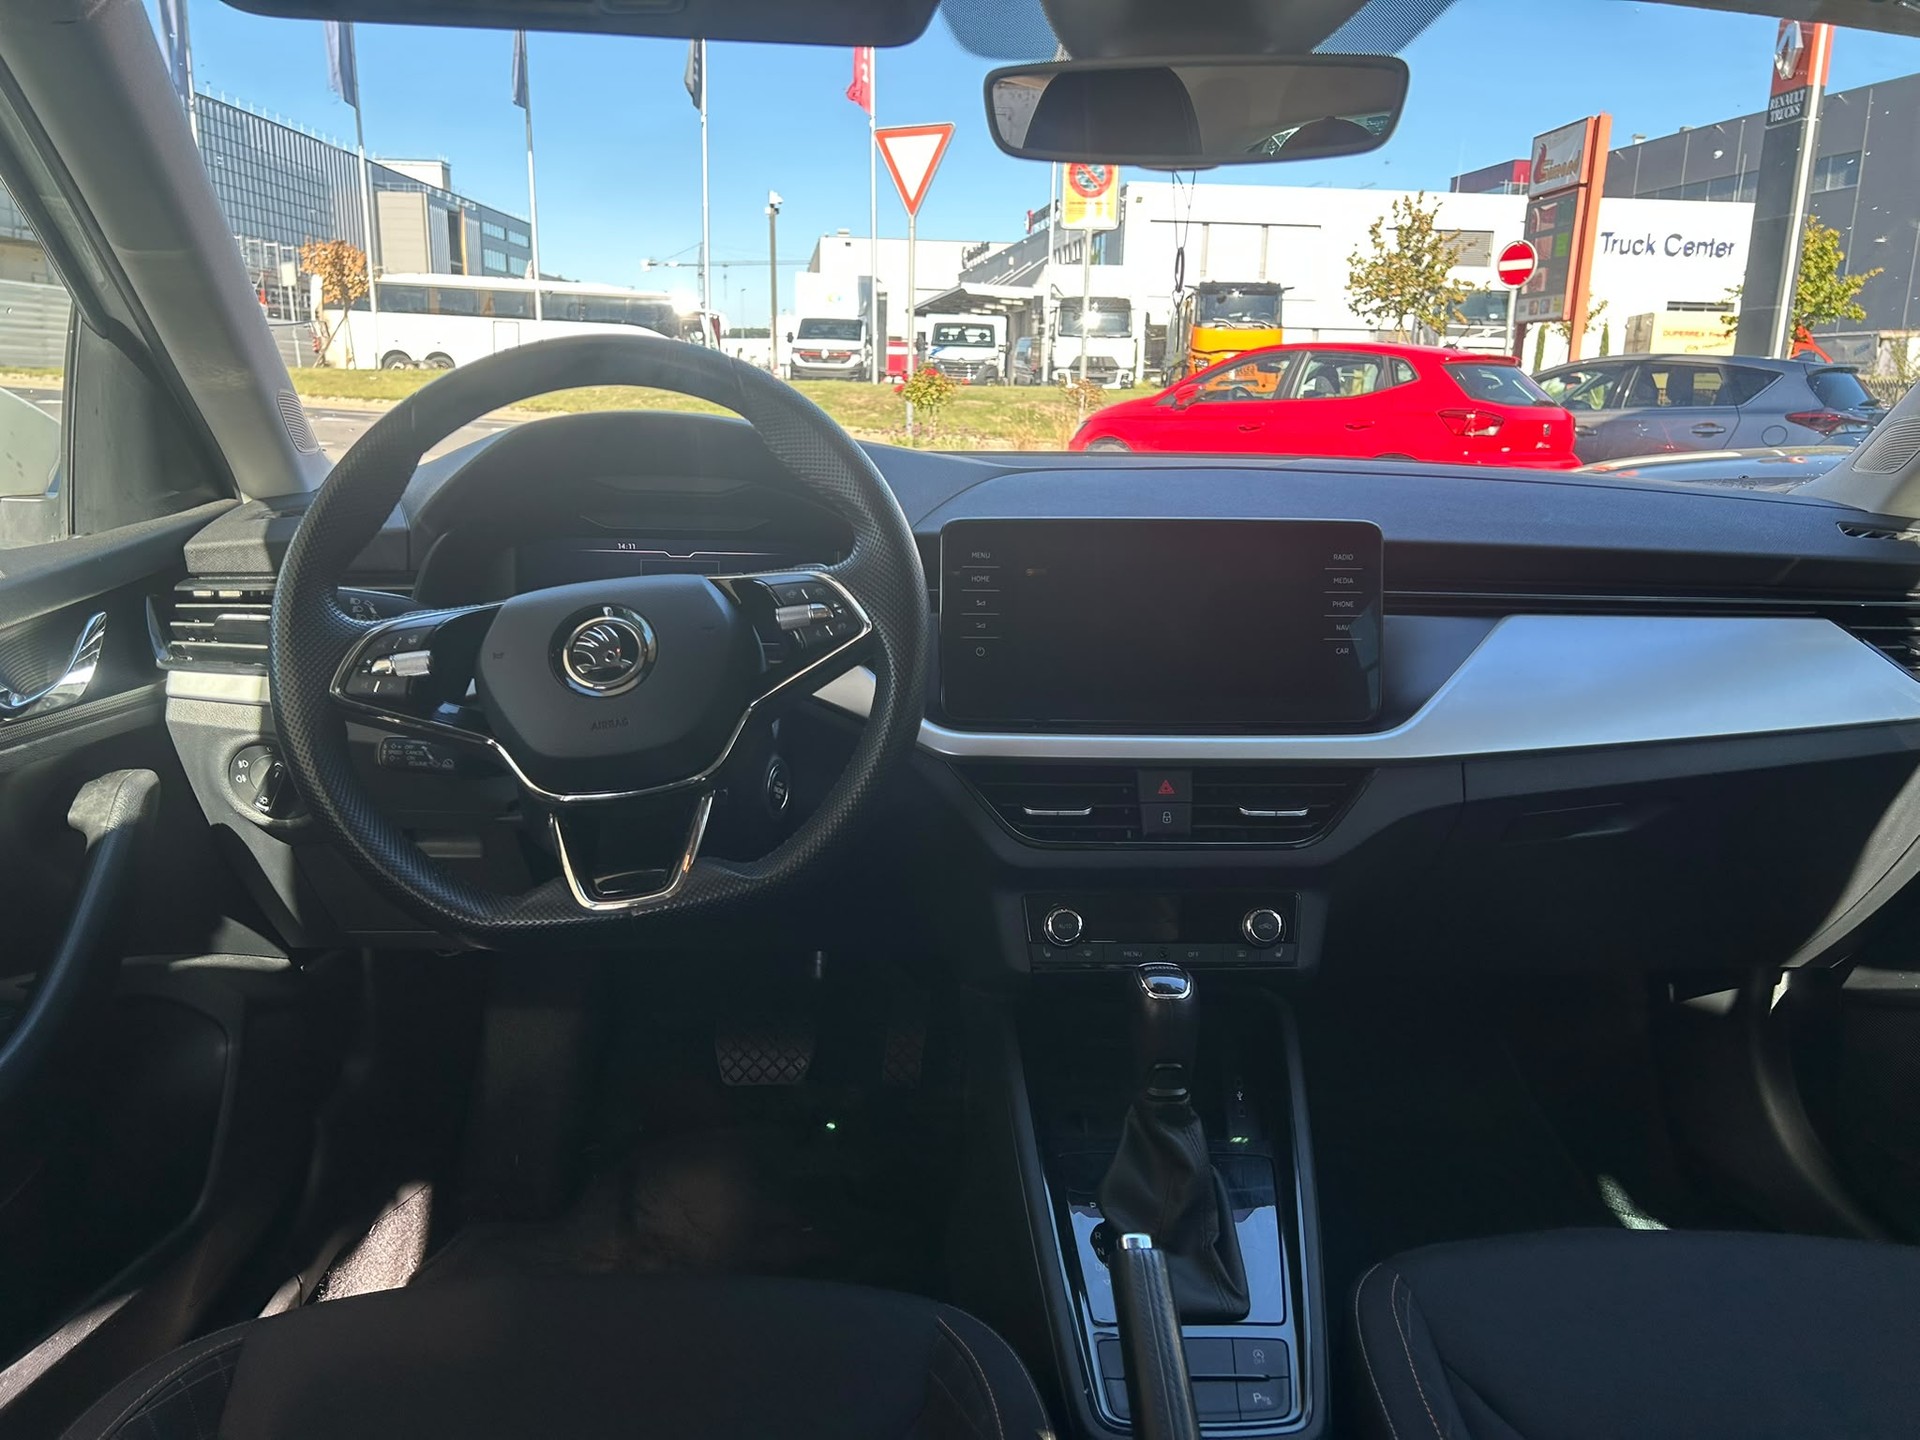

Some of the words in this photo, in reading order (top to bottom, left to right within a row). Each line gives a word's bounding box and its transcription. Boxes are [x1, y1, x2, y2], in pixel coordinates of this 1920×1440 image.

[1600, 231, 1657, 256] Truck
[1663, 233, 1736, 258] Center
[617, 542, 636, 550] 14:11
[971, 551, 991, 559] MENU
[1333, 553, 1354, 561] RADIO
[971, 575, 991, 583] HOME
[1332, 600, 1354, 608] PHONE
[1335, 647, 1350, 655] CAR
[1094, 1231, 1102, 1240] R
[1096, 1247, 1105, 1256] N
